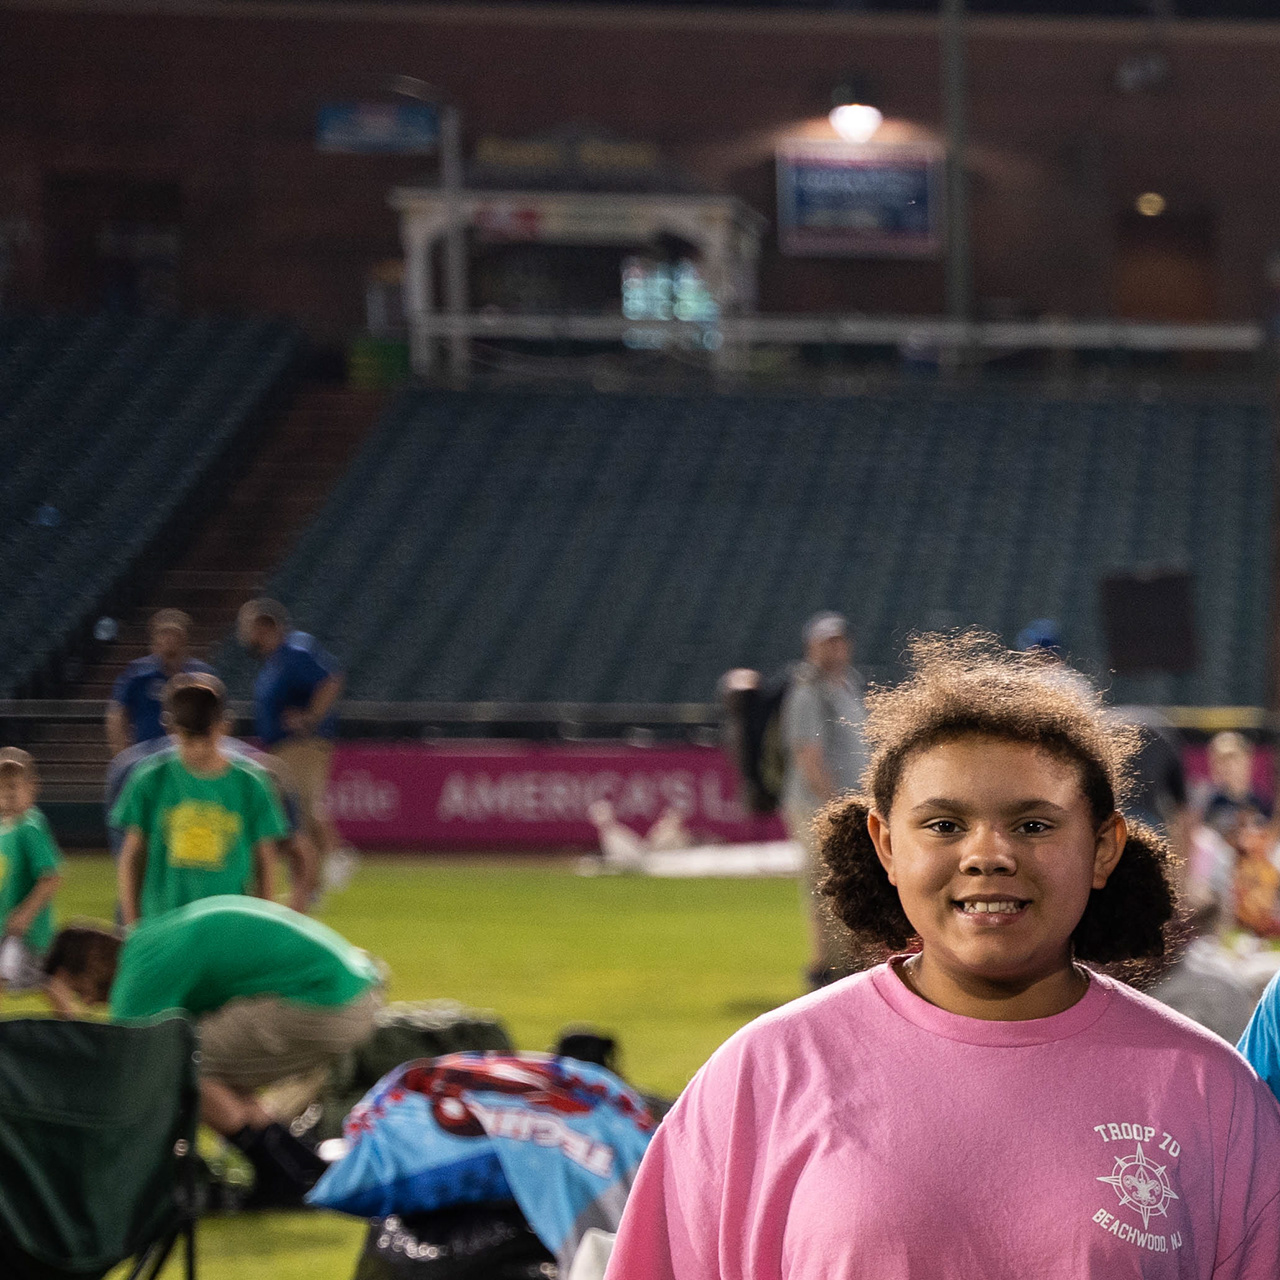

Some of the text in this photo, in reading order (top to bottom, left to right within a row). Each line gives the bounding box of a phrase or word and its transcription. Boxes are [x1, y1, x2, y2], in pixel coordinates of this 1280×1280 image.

[1093, 1122, 1182, 1158] TROOP 70
[1091, 1207, 1183, 1254] BEACHWOOD, NJ
